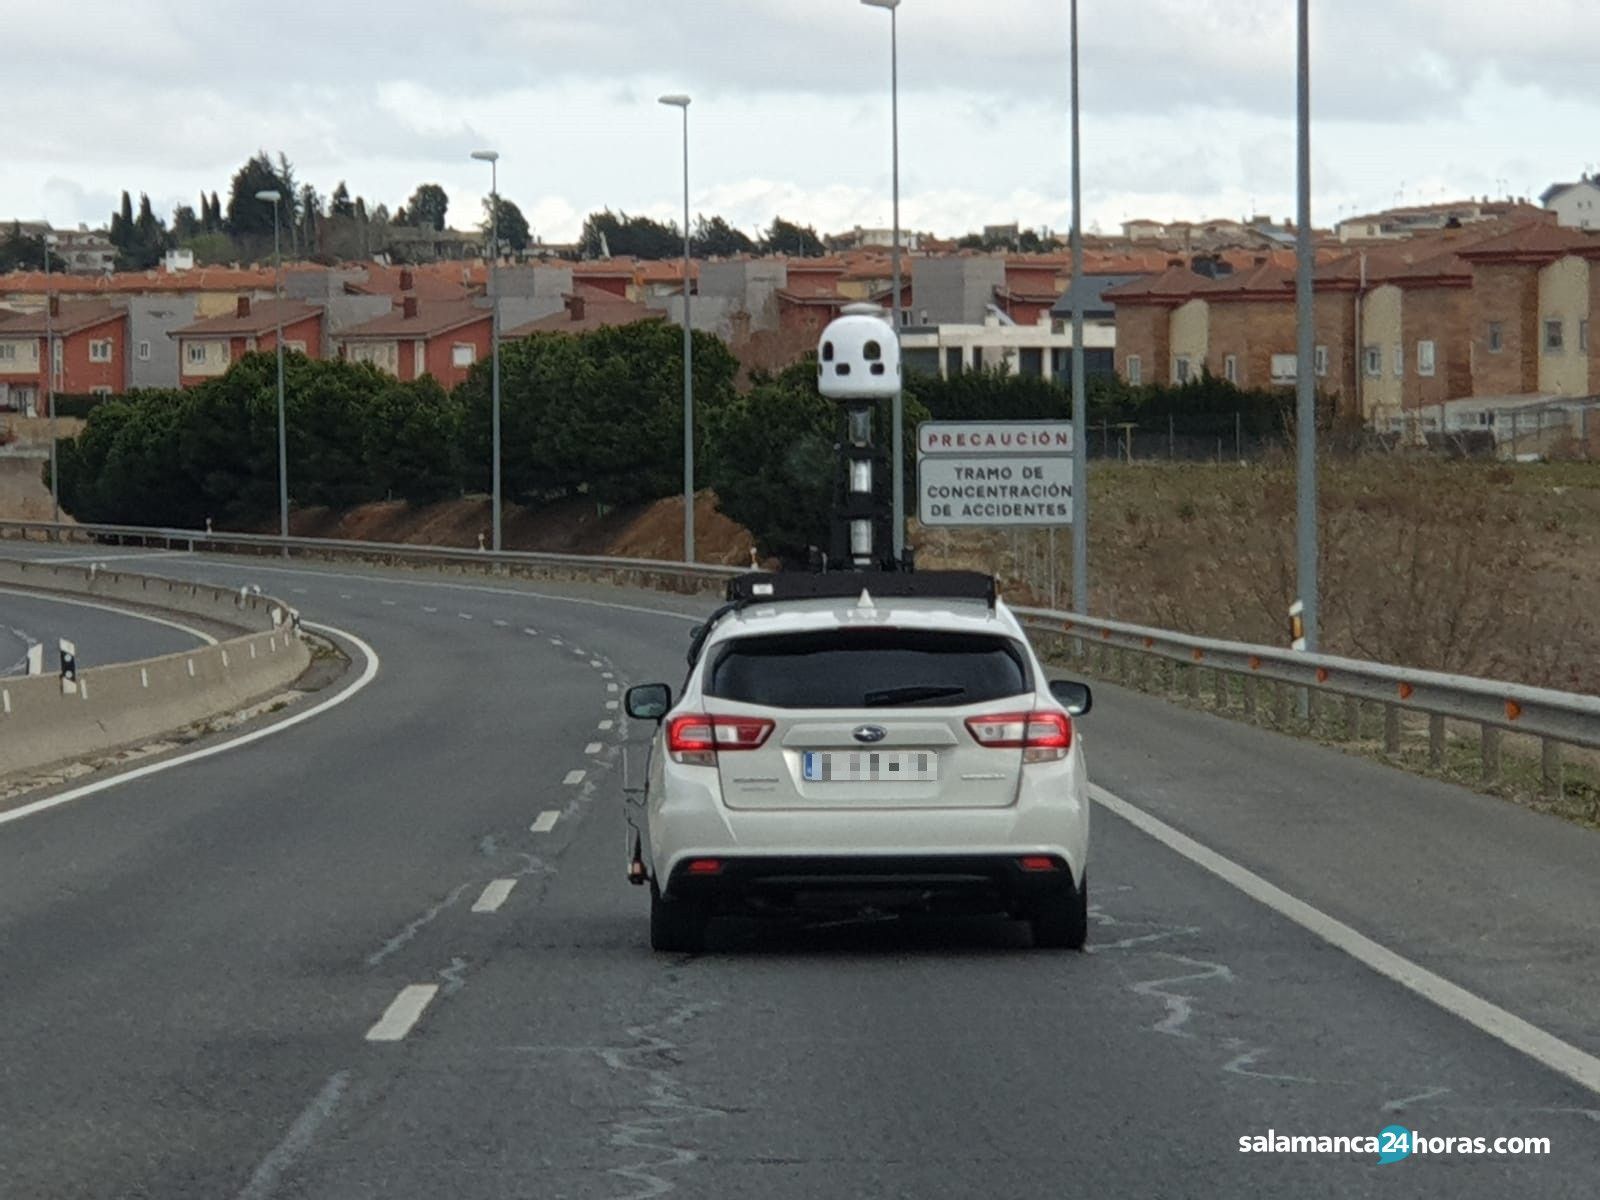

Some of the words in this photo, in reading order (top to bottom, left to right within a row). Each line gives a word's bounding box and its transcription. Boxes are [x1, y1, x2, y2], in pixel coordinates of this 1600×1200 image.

[928, 431, 1068, 447] PRECAUCIÓN
[954, 466, 1012, 480] TRAMO
[1022, 466, 1043, 479] DE
[927, 484, 1073, 499] CONCENTRACIÓN
[931, 504, 952, 516] DE
[962, 503, 1067, 517] ACCIDENTES
